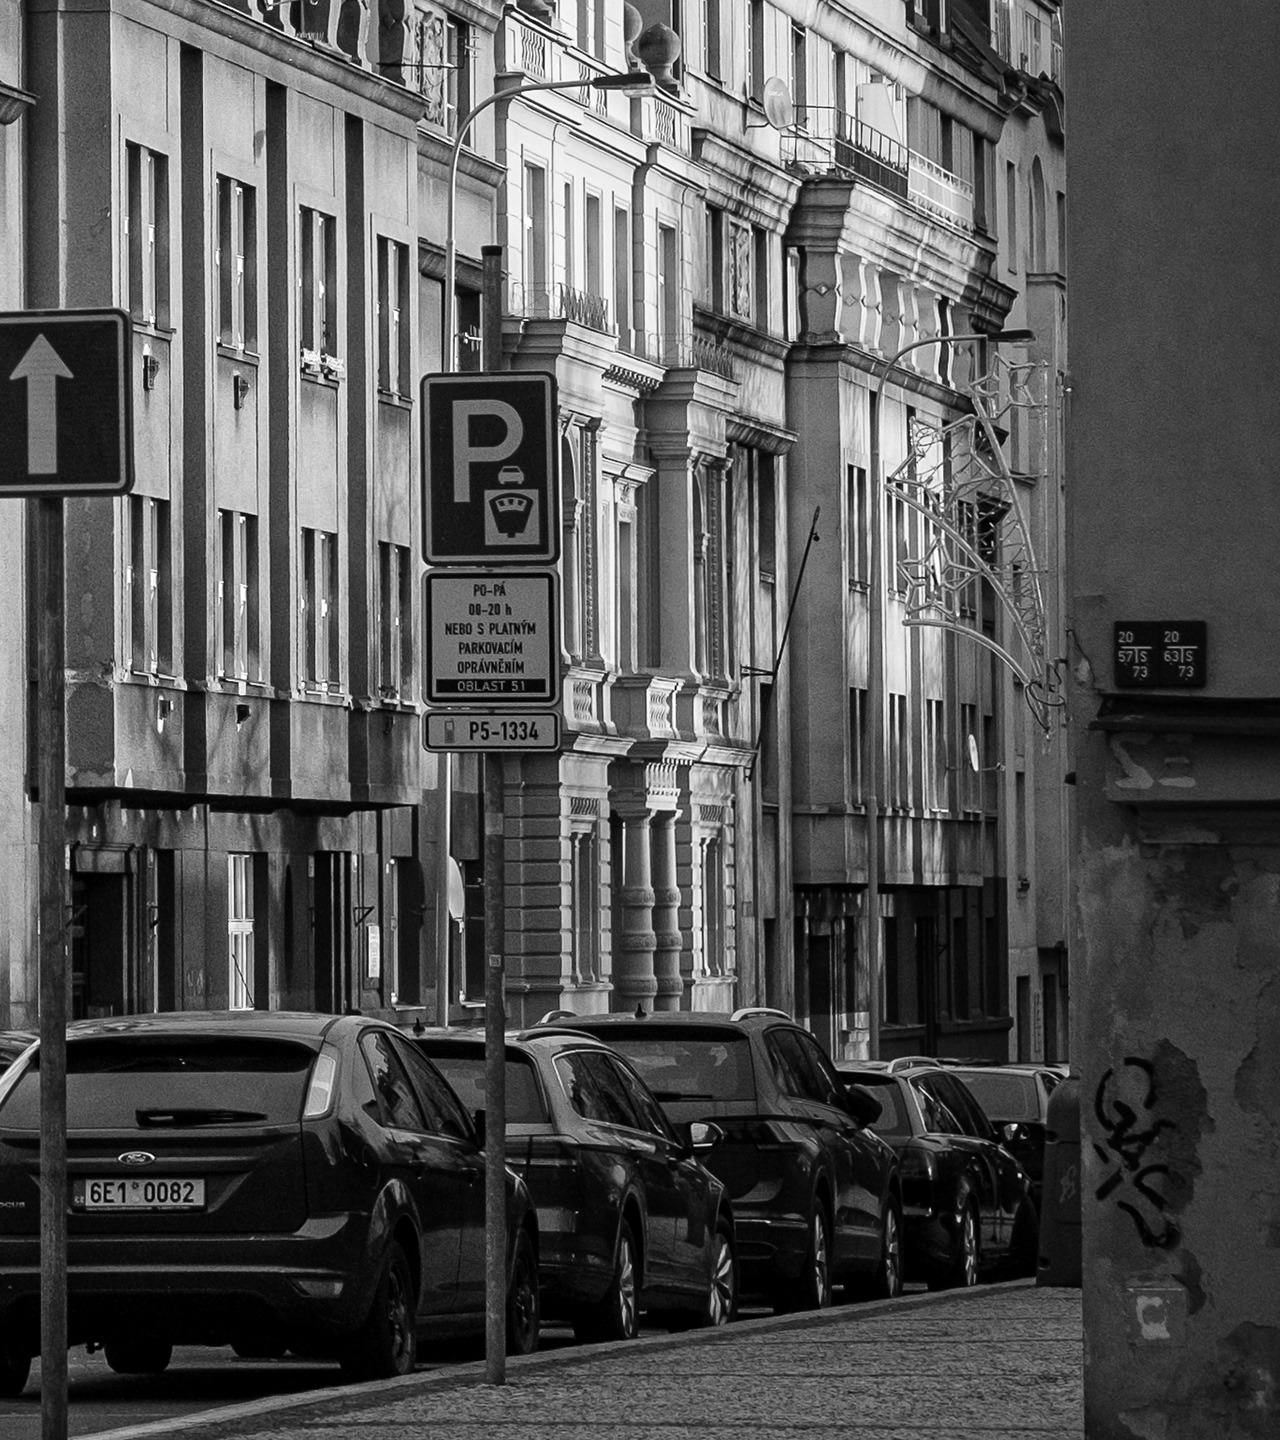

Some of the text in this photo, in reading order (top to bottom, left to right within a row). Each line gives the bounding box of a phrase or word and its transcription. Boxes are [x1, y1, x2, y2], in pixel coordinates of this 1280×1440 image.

[452, 399, 524, 504] P
[473, 581, 507, 596] PO-PÁ
[468, 603, 512, 616] 08-20 h
[444, 619, 536, 635] NEBO S PLATNÝM
[1118, 631, 1134, 643] 20
[1164, 631, 1179, 643] 20
[458, 639, 523, 655] PARKOVACÍM
[457, 658, 525, 674] OPRÁVNĚNÍM
[1132, 665, 1148, 678] 73
[1178, 665, 1194, 678] 73
[457, 680, 525, 692] OBLAST 51
[469, 721, 539, 740] P5-1334
[90, 1181, 127, 1204] 6E1
[143, 1181, 195, 1204] 0082
